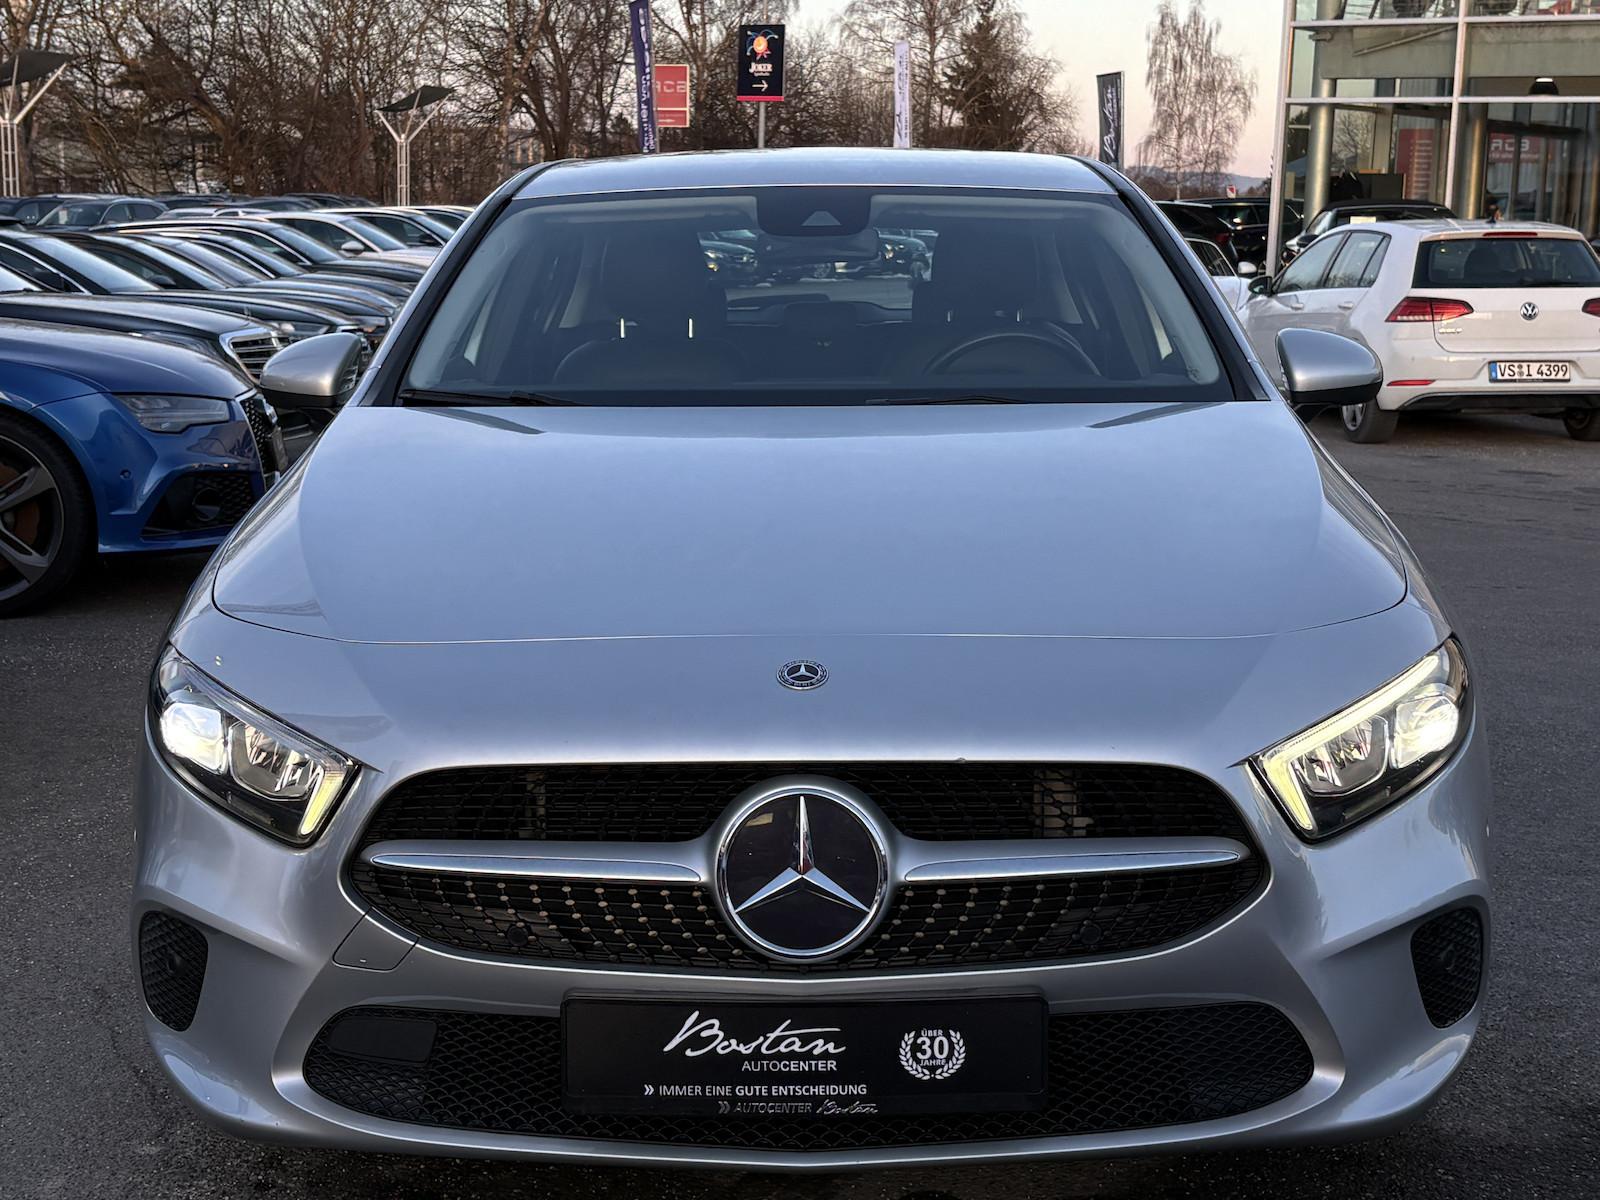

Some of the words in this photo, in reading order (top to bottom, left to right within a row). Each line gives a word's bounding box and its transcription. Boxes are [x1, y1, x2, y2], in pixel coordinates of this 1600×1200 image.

[1536, 364, 1569, 377] 4399
[663, 1010, 847, 1057] Bostan
[916, 1036, 950, 1060] 30
[741, 1060, 838, 1072] AUTOCENTER
[919, 1059, 946, 1067] JAHRE
[659, 1084, 702, 1097] IMMER
[705, 1084, 733, 1097] EINE
[735, 1084, 769, 1097] GUTE
[771, 1084, 868, 1097] ENTSCHEIDUNG
[733, 1102, 813, 1114] AUTOCENTER
